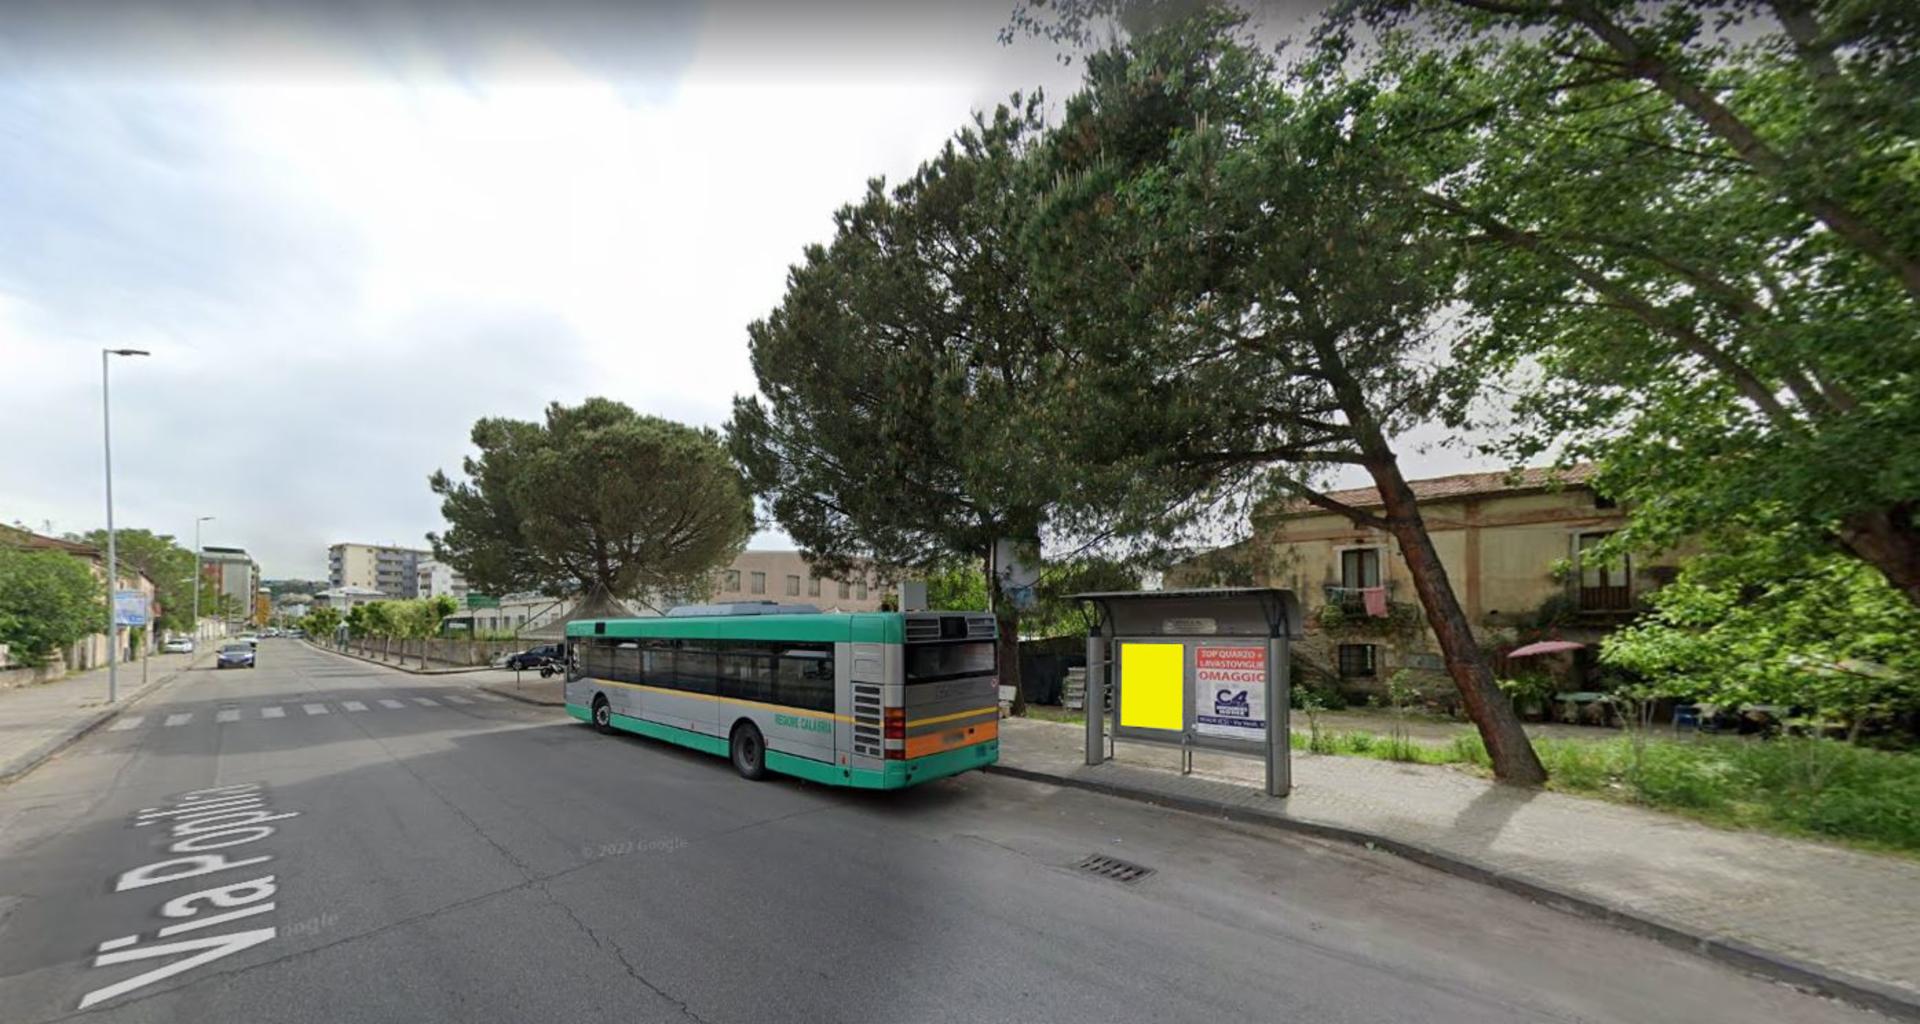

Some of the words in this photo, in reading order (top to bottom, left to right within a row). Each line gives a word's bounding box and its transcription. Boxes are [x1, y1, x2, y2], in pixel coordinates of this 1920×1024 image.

[1217, 689, 1248, 704] C4
[775, 713, 799, 728] REGIONE
[801, 718, 832, 733] CALABRIA
